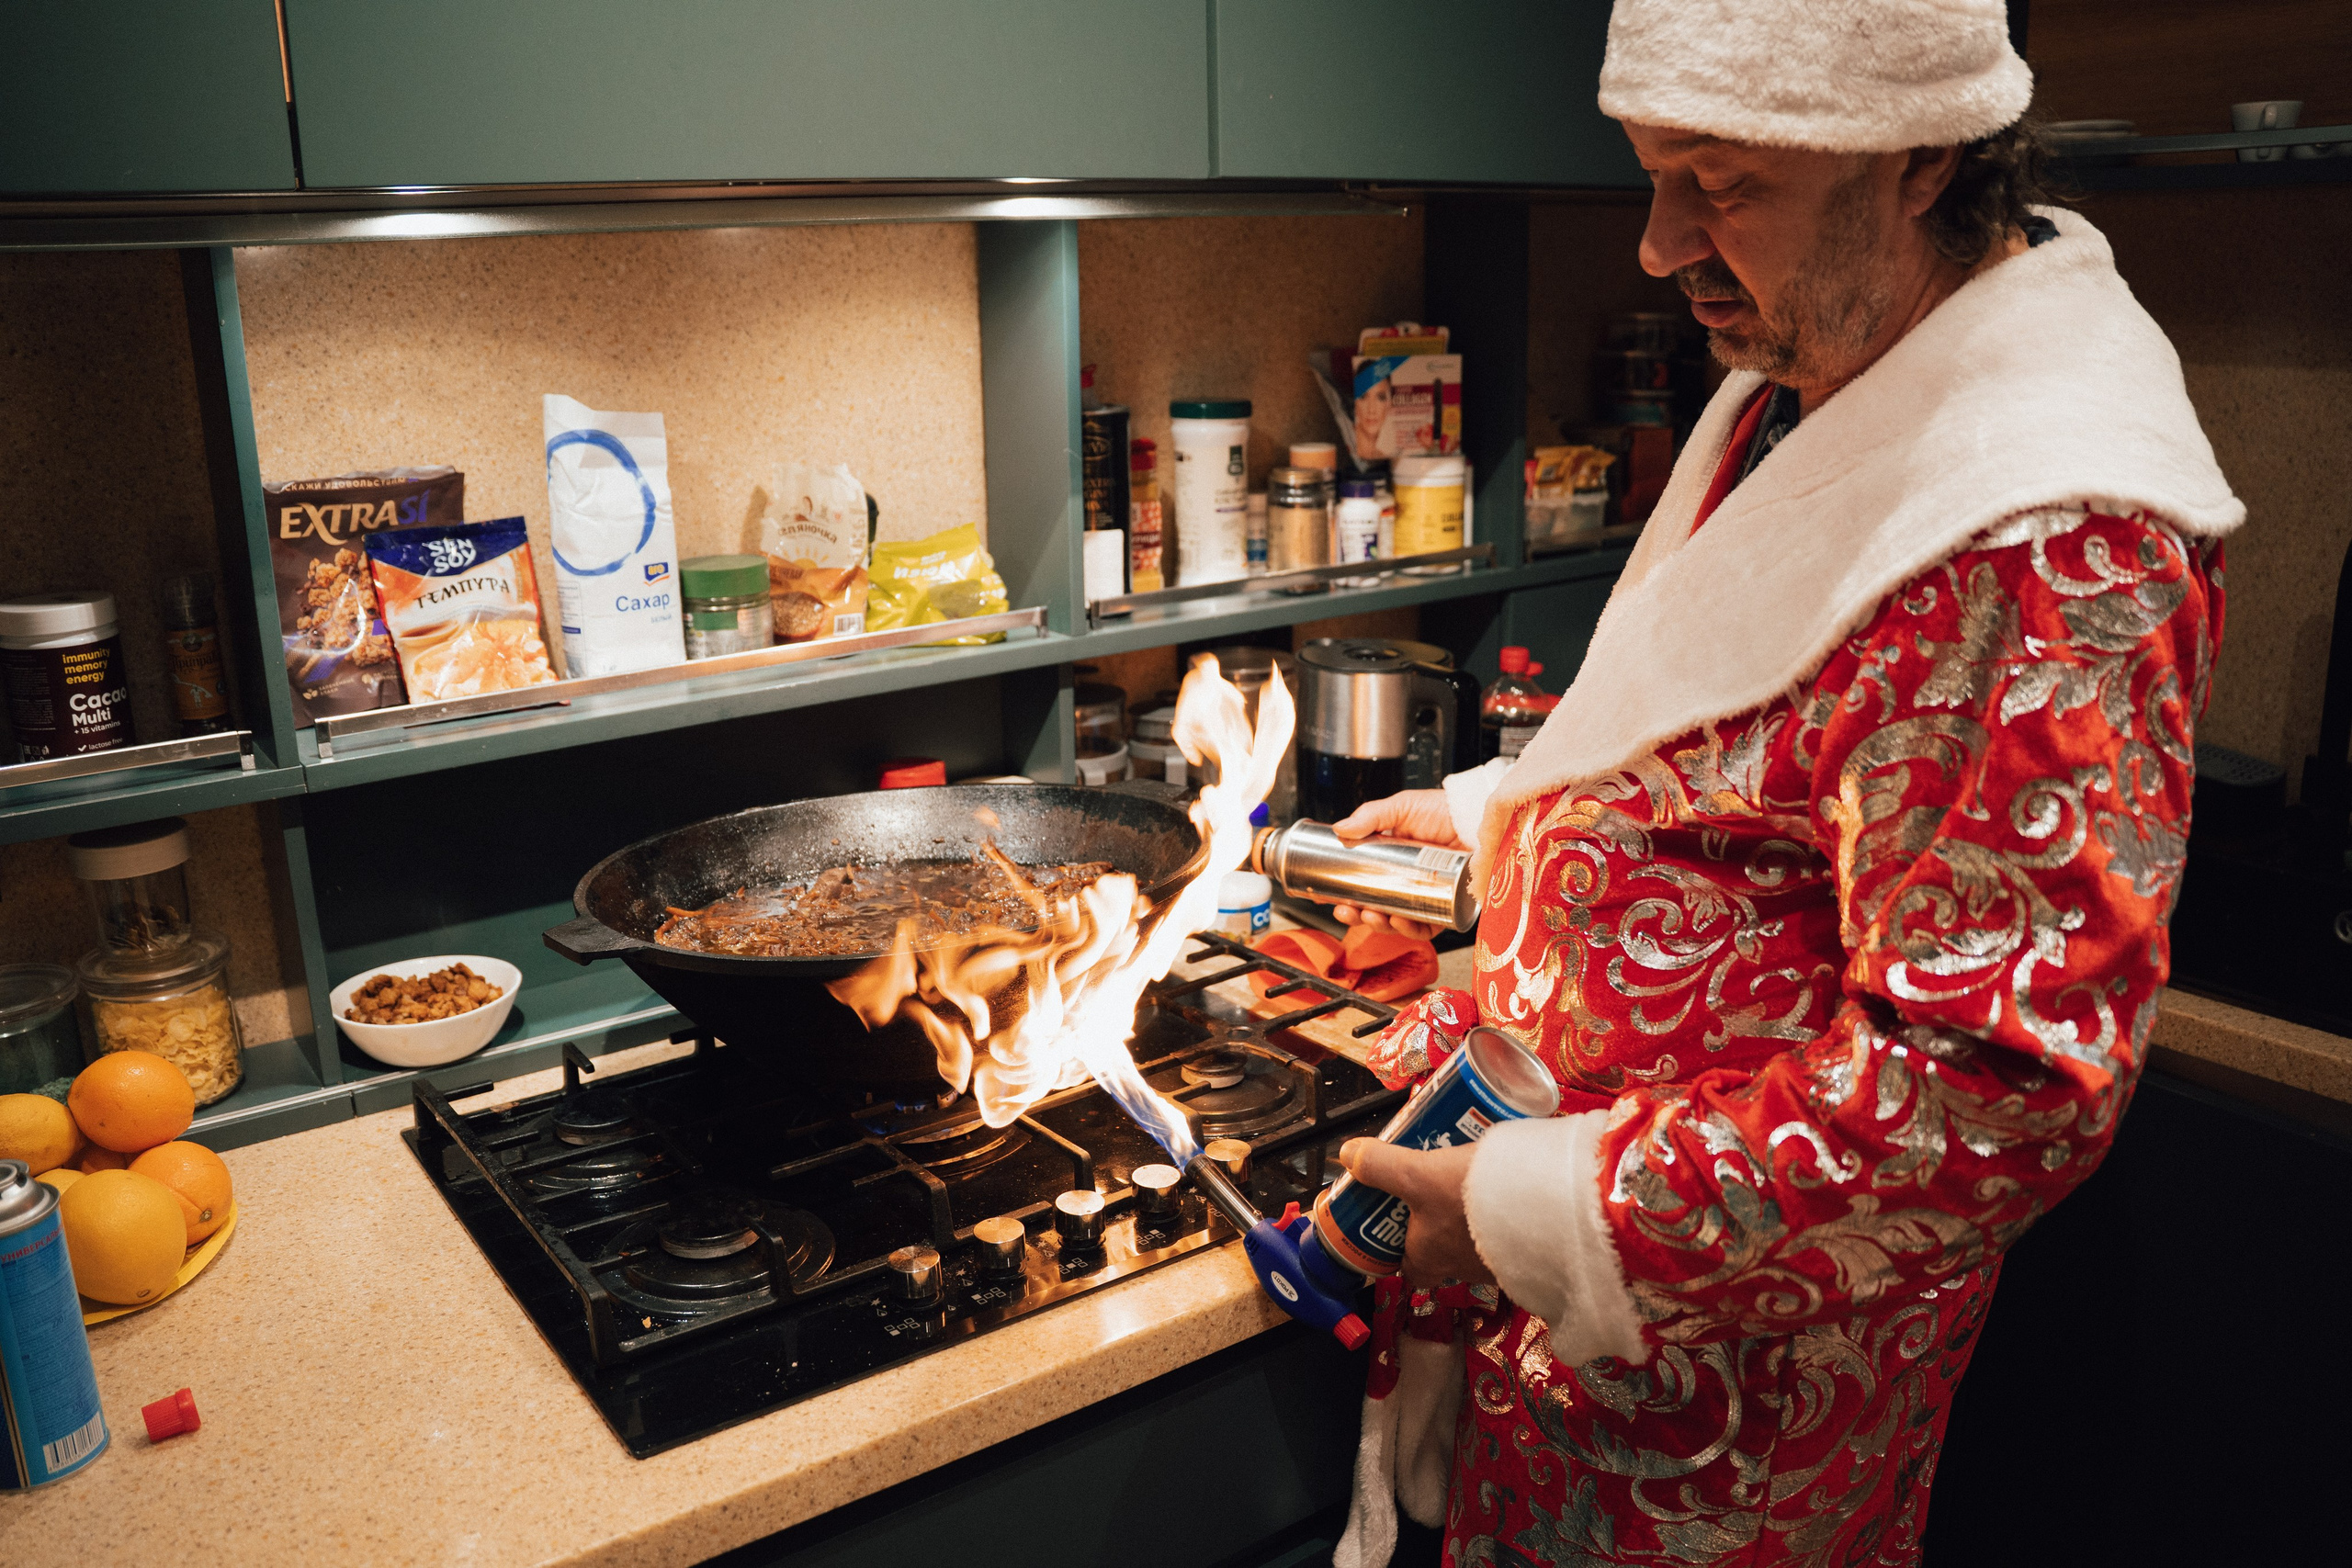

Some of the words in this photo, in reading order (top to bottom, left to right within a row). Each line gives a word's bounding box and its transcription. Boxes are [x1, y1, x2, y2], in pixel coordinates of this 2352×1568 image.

[434, 549, 477, 574] SOY
[416, 577, 510, 608] ТЕМПУРА
[616, 593, 670, 612] Сахар
[62, 648, 109, 664] immunity
[64, 660, 107, 674] memory
[66, 671, 105, 685] energy
[69, 686, 127, 712] Cacao
[72, 707, 111, 727] Multi
[81, 727, 90, 735] 15
[91, 720, 120, 732] vitamins
[89, 740, 112, 750] lactose
[1371, 1216, 1407, 1248] АШ
